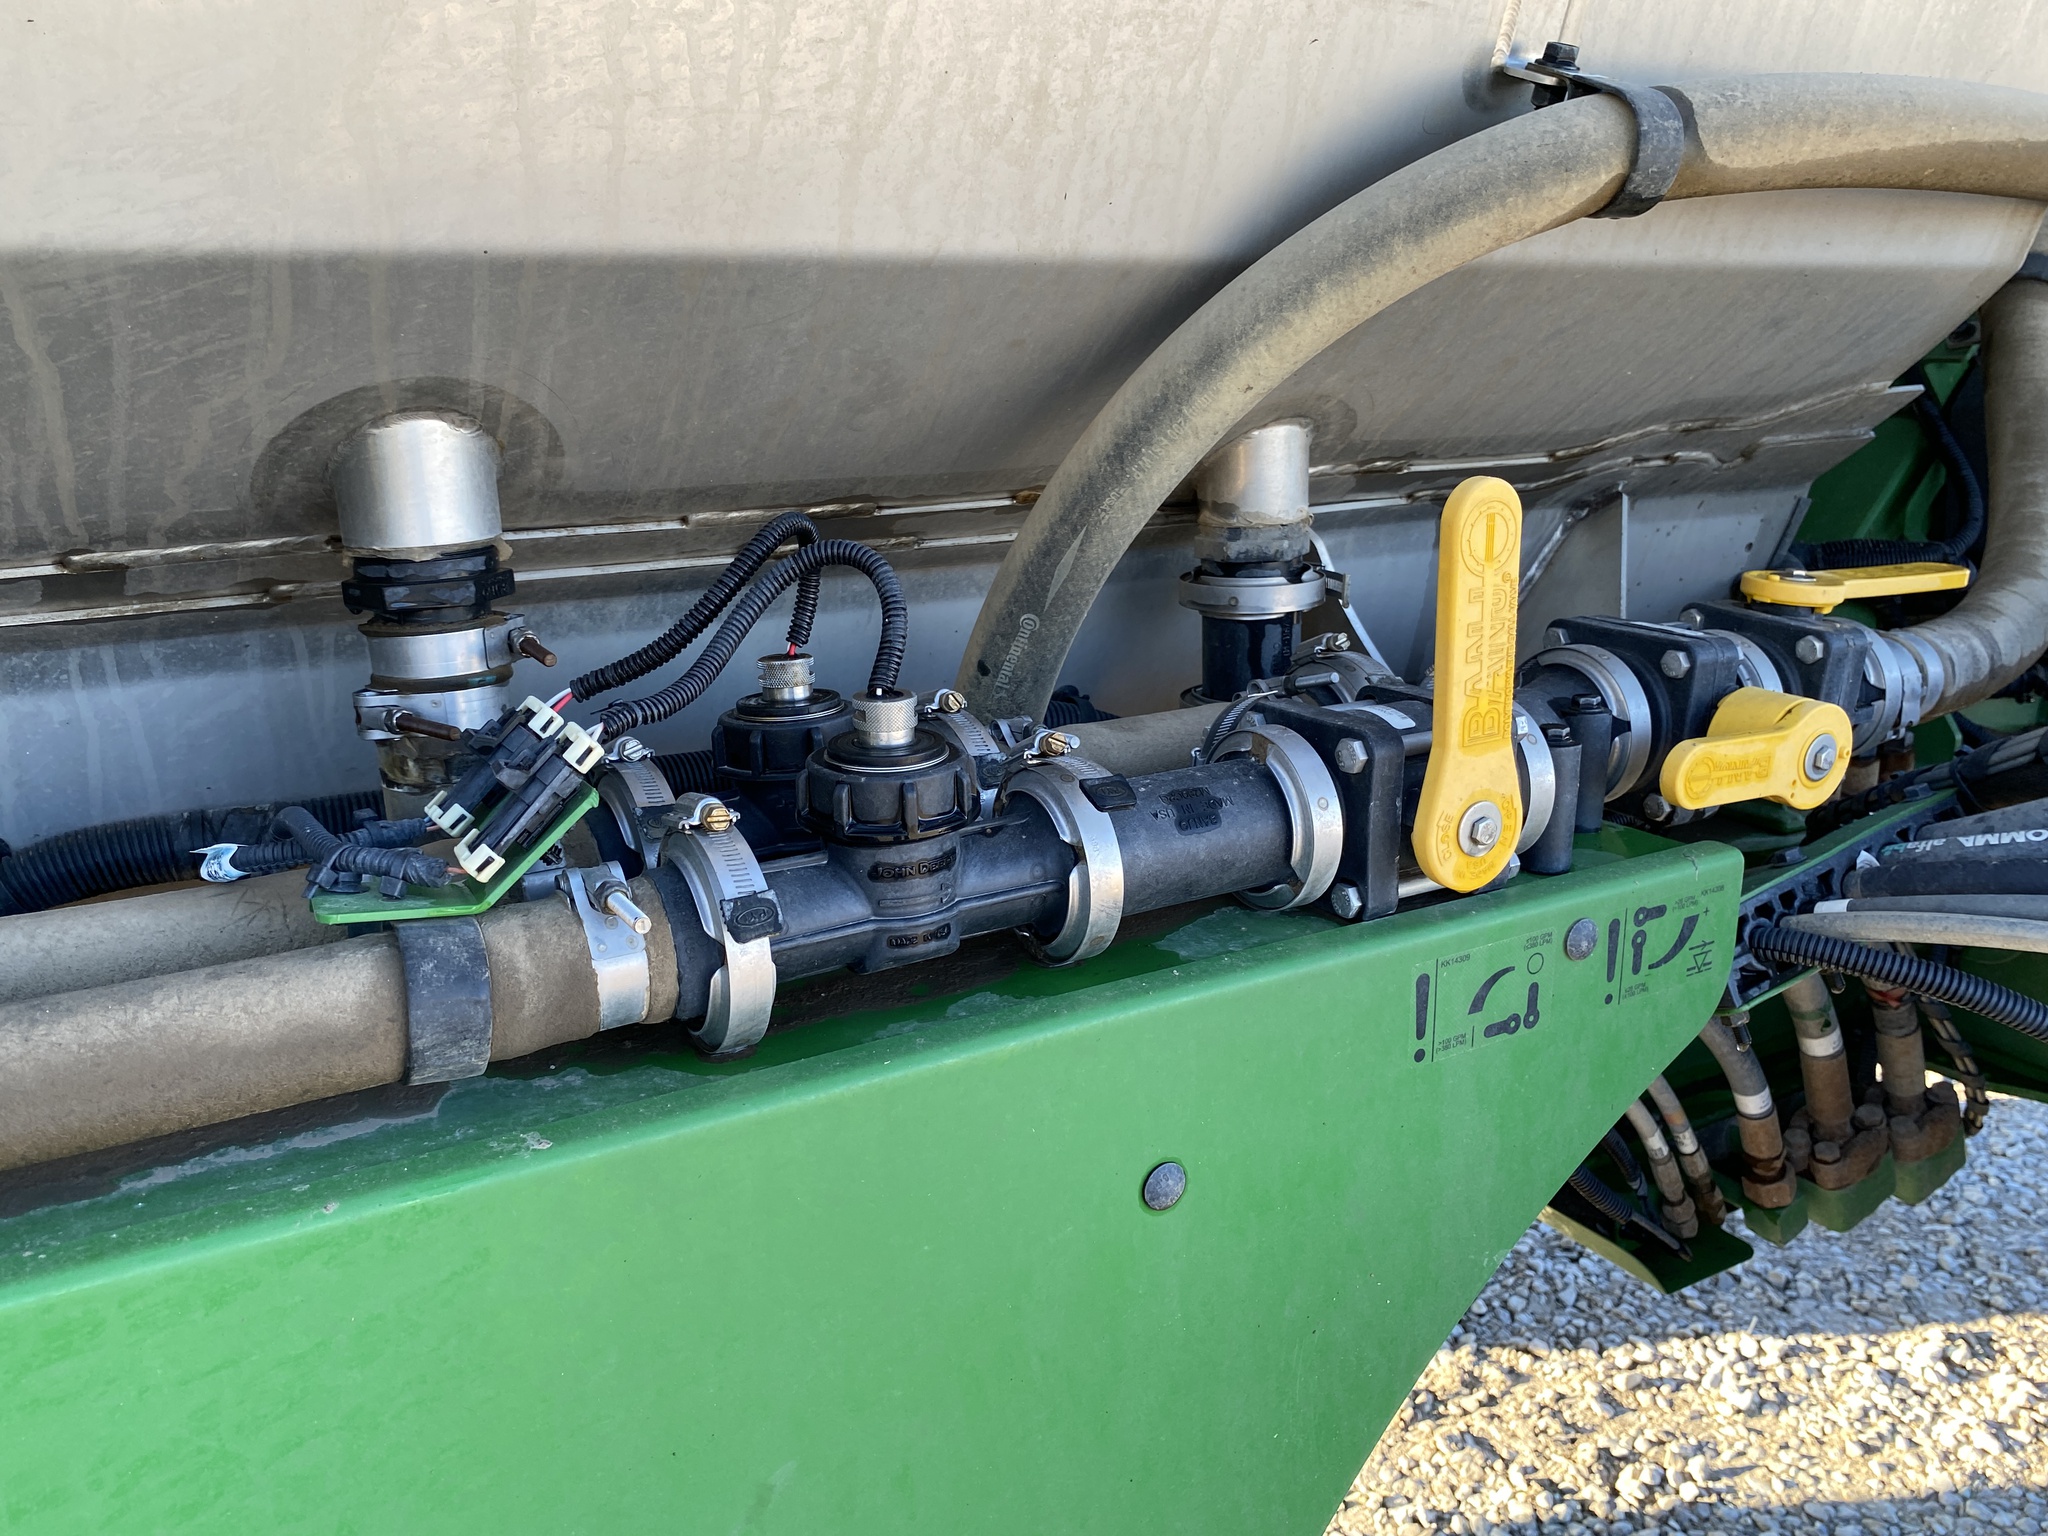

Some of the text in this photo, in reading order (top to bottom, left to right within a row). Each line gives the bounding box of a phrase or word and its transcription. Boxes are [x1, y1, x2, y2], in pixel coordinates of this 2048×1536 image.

[1099, 491, 1121, 512] USA
[993, 613, 1040, 689] Continental
[1150, 809, 1176, 821] USA
[876, 866, 916, 878] JOHN
